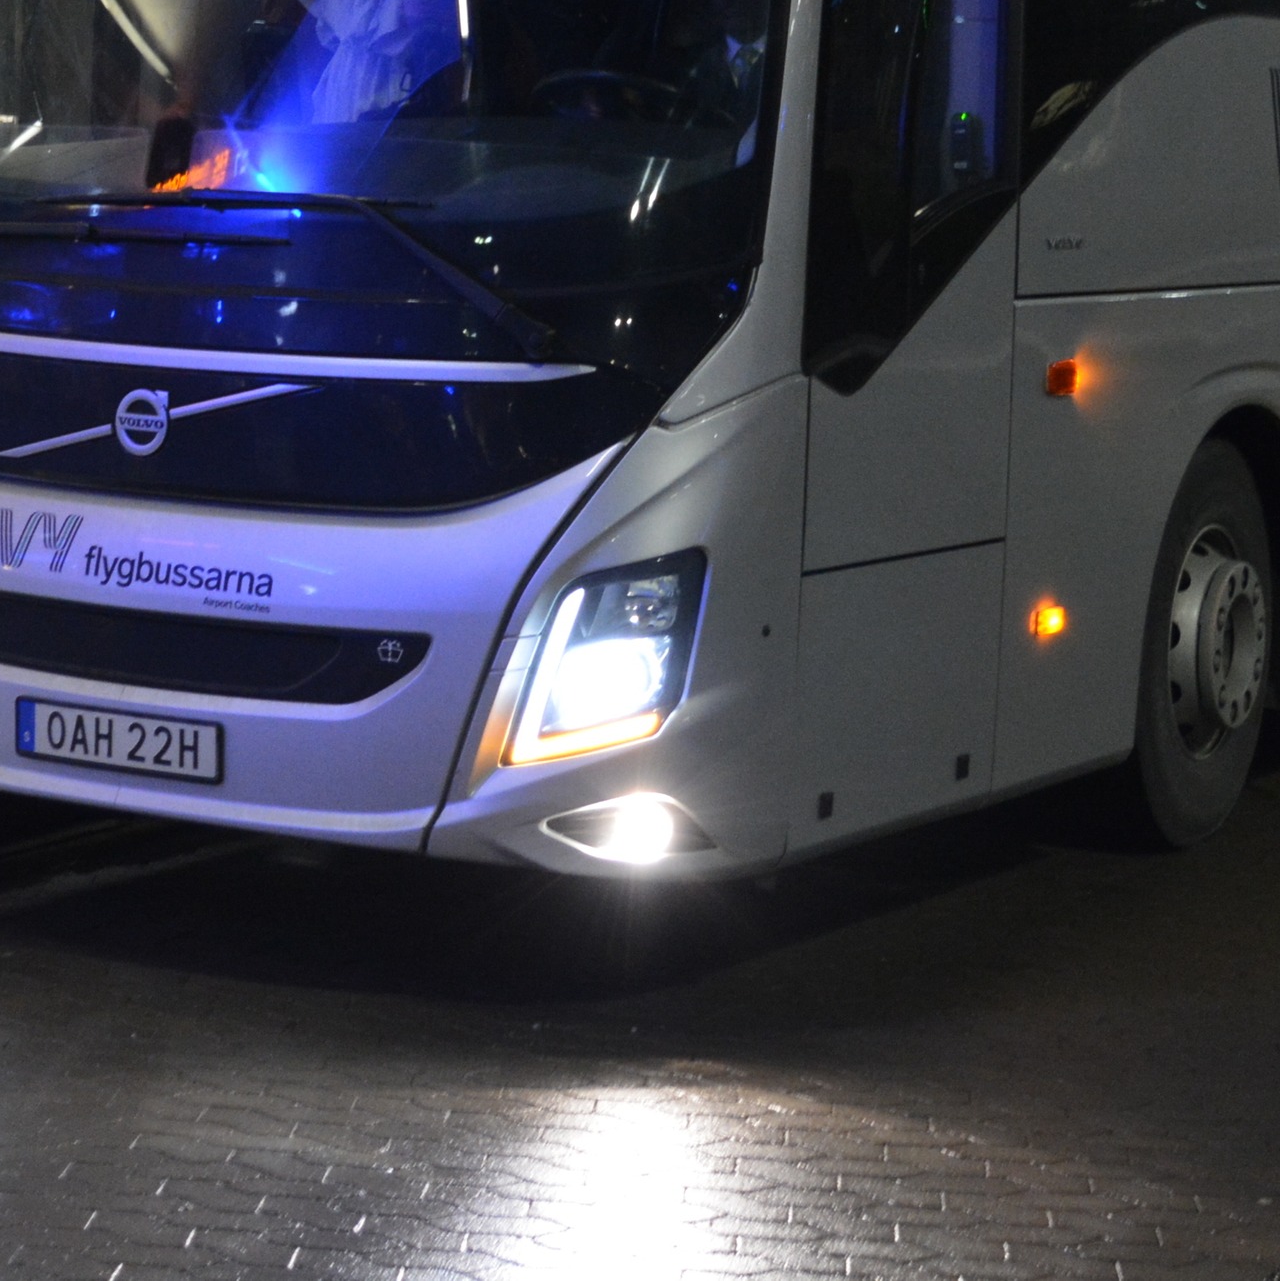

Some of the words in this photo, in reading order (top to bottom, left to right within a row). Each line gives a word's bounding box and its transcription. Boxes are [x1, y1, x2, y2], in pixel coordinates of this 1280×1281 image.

[119, 415, 166, 431] VOLVO
[84, 545, 274, 598] flygbussarna
[203, 596, 233, 609] Airport
[234, 600, 271, 614] Coaches
[47, 710, 114, 759] OAH
[127, 722, 200, 770] 22H
